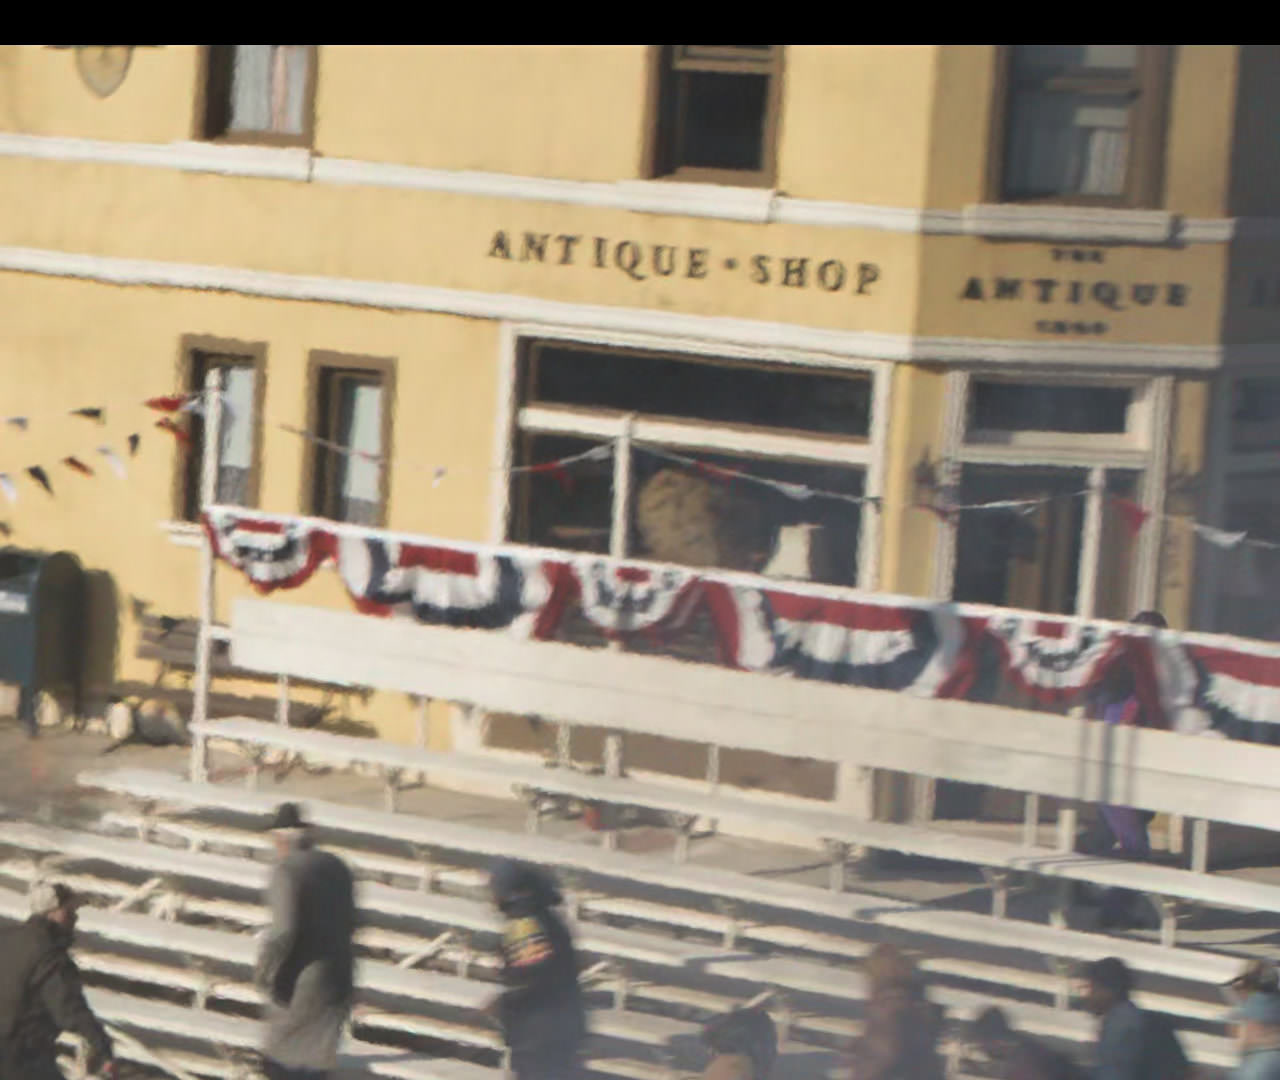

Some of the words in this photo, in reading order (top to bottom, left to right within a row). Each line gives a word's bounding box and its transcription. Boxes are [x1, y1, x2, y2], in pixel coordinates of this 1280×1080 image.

[488, 230, 708, 281] ANTIQUE
[752, 253, 881, 295] SHOP
[960, 277, 1189, 311] ANTIQUE
